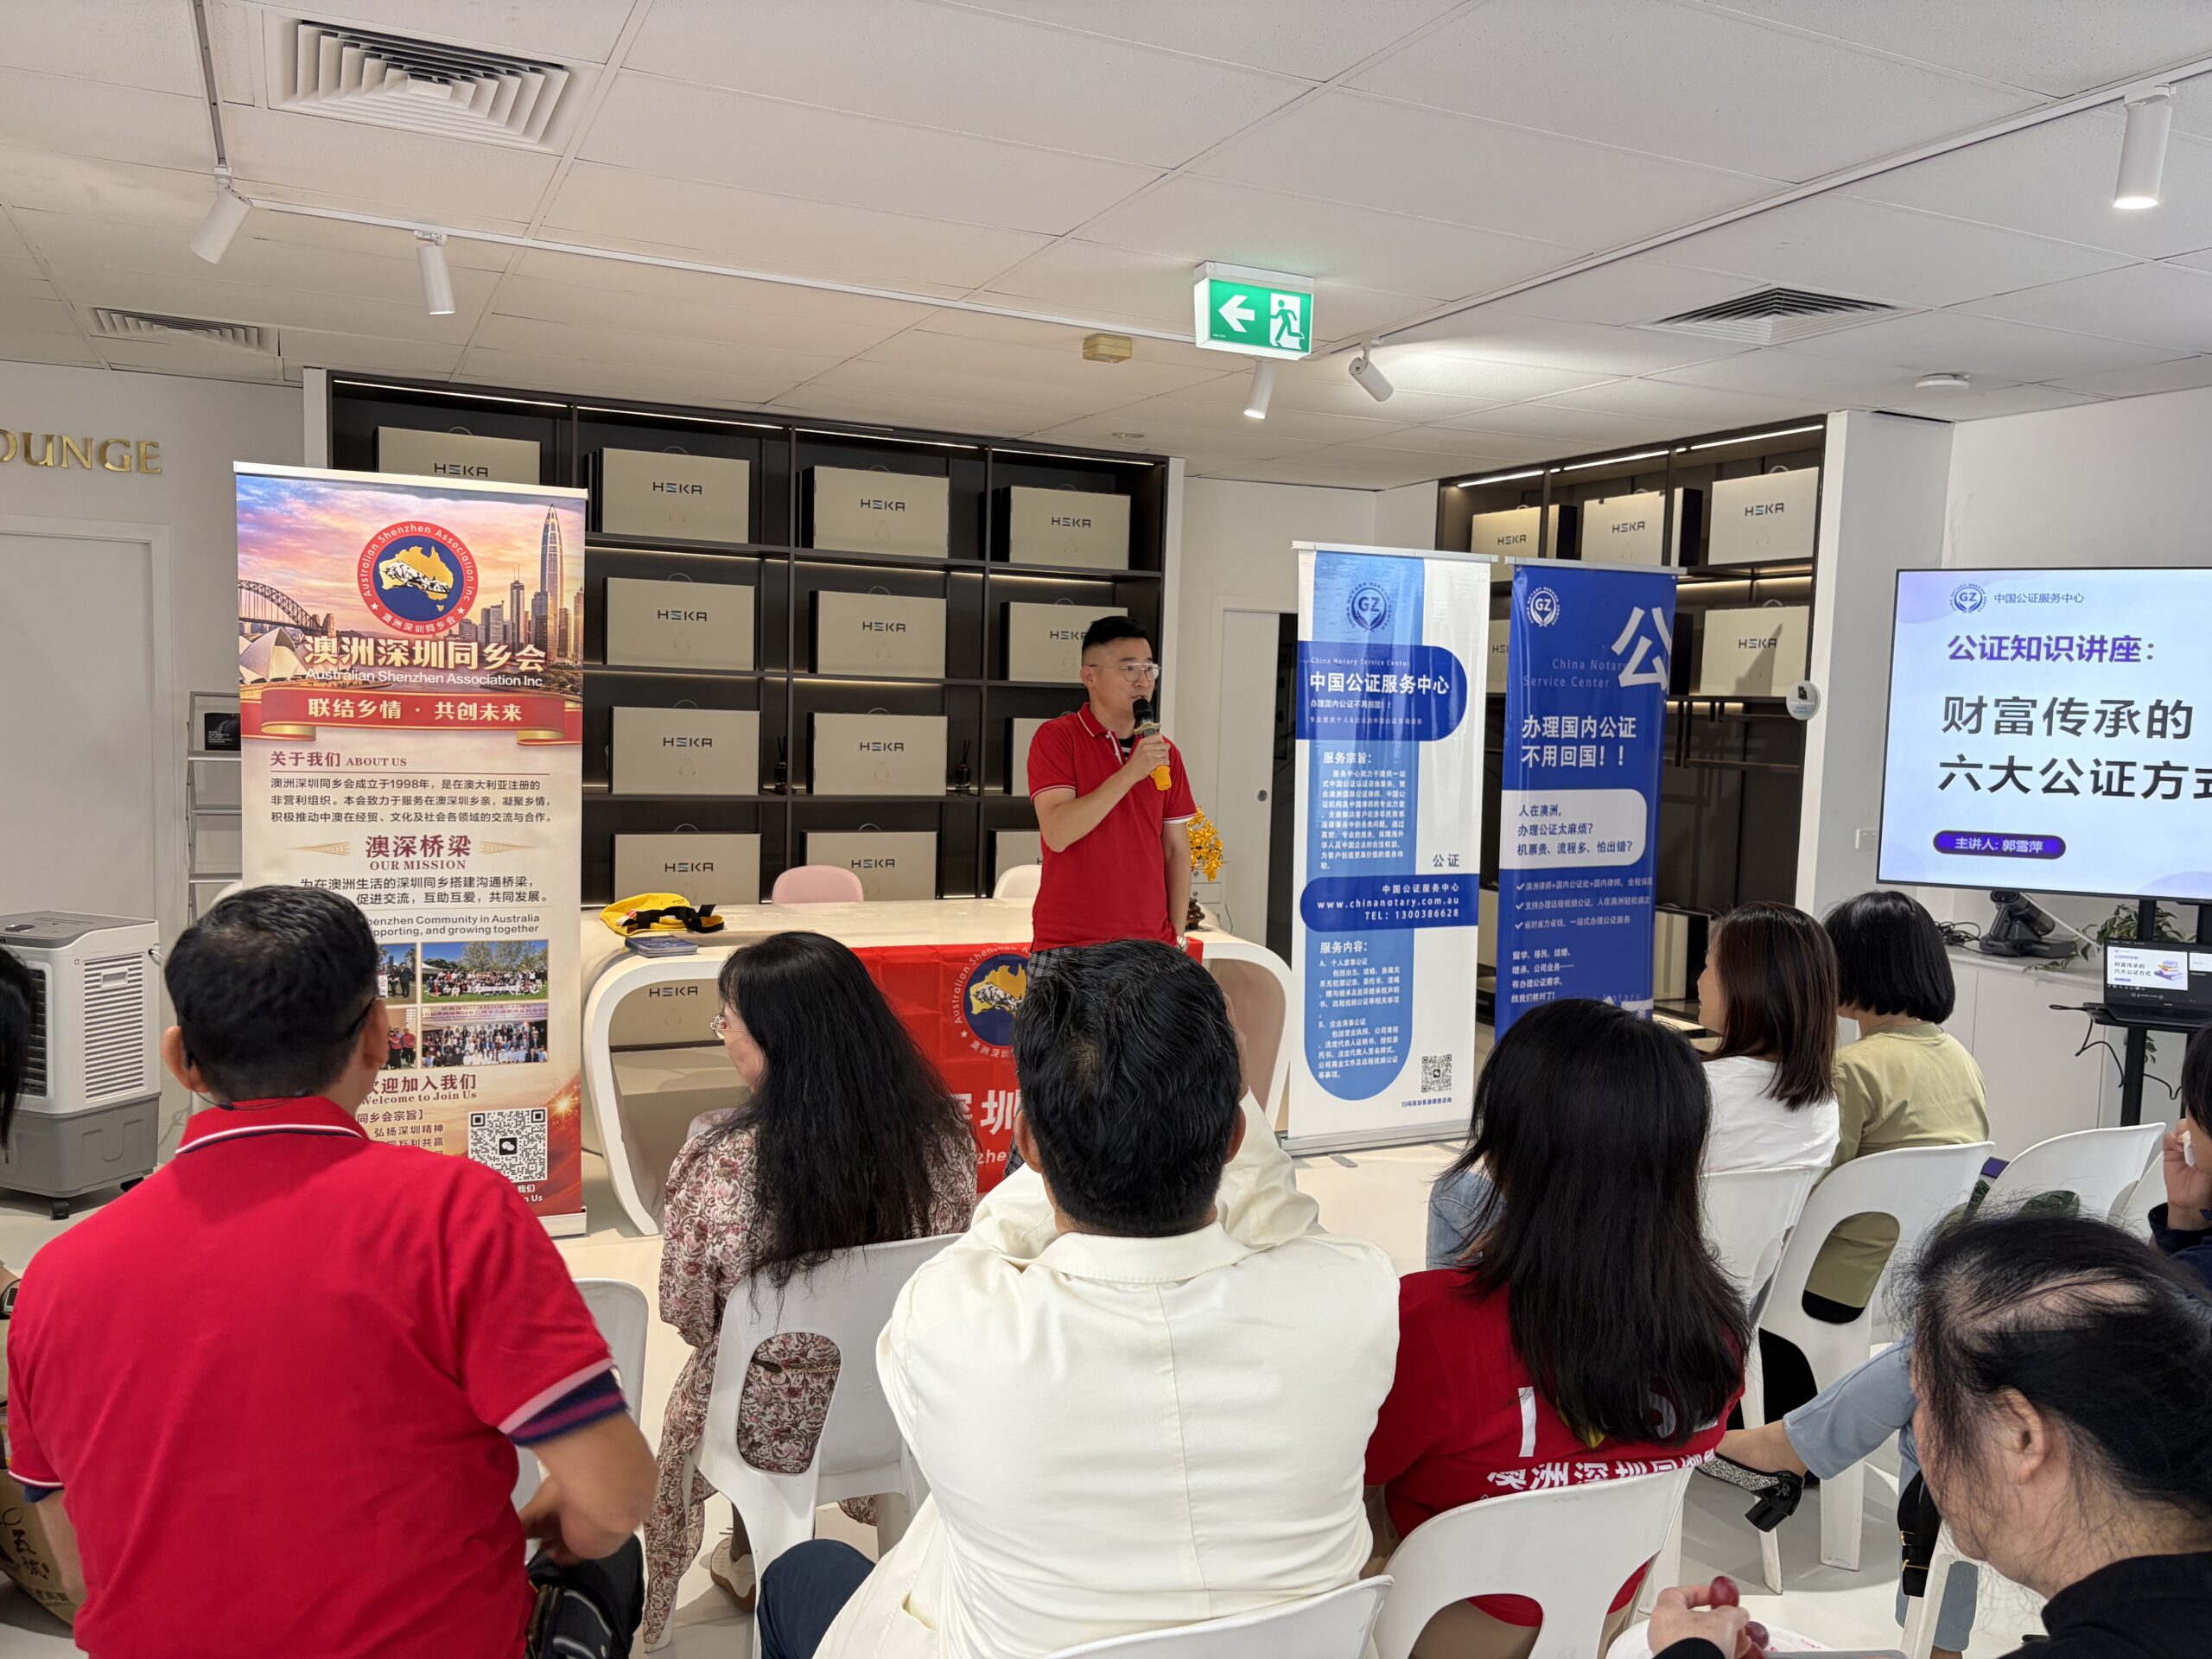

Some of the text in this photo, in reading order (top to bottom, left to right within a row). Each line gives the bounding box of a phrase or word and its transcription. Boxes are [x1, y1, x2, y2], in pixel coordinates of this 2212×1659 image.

[434, 463, 489, 478] HEKA
[652, 481, 702, 495] HEKA
[861, 499, 906, 512] HEKA
[1745, 502, 1784, 518] HEKA
[1051, 517, 1091, 528] HEKA
[1611, 521, 1645, 534] HEKA
[1497, 534, 1527, 546] HEKA
[361, 524, 474, 601] Australian Shenzhen Association Inc
[1959, 592, 1977, 602] GZ
[1993, 593, 2085, 604] 中国公证服务中心
[1357, 596, 1380, 612] GZ
[1535, 598, 1552, 611] GZ
[657, 609, 708, 622] HEKA
[381, 612, 456, 633] 澳洲深圳同乡会
[862, 620, 906, 632] HEKA
[1611, 607, 1673, 692] 公
[1738, 638, 1777, 650] HEKA
[1947, 634, 2155, 663] 公证知识讲座：
[304, 635, 546, 672] 澳洲深圳同乡会
[1333, 658, 1357, 666] Notary
[1552, 658, 1586, 670] China
[305, 668, 543, 686] Australian Shenzhen Association Inc
[1310, 671, 1450, 695] 中国公证服务中心
[1522, 675, 1610, 688] Service Center
[308, 697, 522, 721] 联结乡情 共创未来
[1942, 696, 2194, 740] 财富传承的
[1521, 714, 1637, 740] 办理国内公证
[663, 737, 713, 748] HEKA
[860, 741, 905, 753] HEKA
[270, 751, 407, 767] 关于我们 ABOUT US
[365, 834, 472, 858] 澳深桥梁
[370, 860, 467, 870] OUR MISSION
[664, 861, 714, 873] HEKA
[850, 858, 895, 869] HEKA
[1433, 854, 1460, 868] 公证
[1382, 882, 1459, 894] 中国公证服务中心
[1317, 895, 1459, 909] www.chinanotary.com.au
[416, 914, 478, 926] Community
[480, 915, 490, 924] in
[493, 913, 540, 924] Australia
[1395, 908, 1459, 920] 1300386628
[426, 925, 446, 934] and
[448, 925, 492, 937] growing
[494, 924, 538, 935] together
[649, 986, 698, 998] HEKA
[952, 966, 970, 1024] Australian
[363, 1094, 415, 1105] Welcome
[434, 1090, 459, 1101] Join
[462, 1090, 477, 1100] Us
[374, 1124, 444, 1137] 弘扬深圳精神
